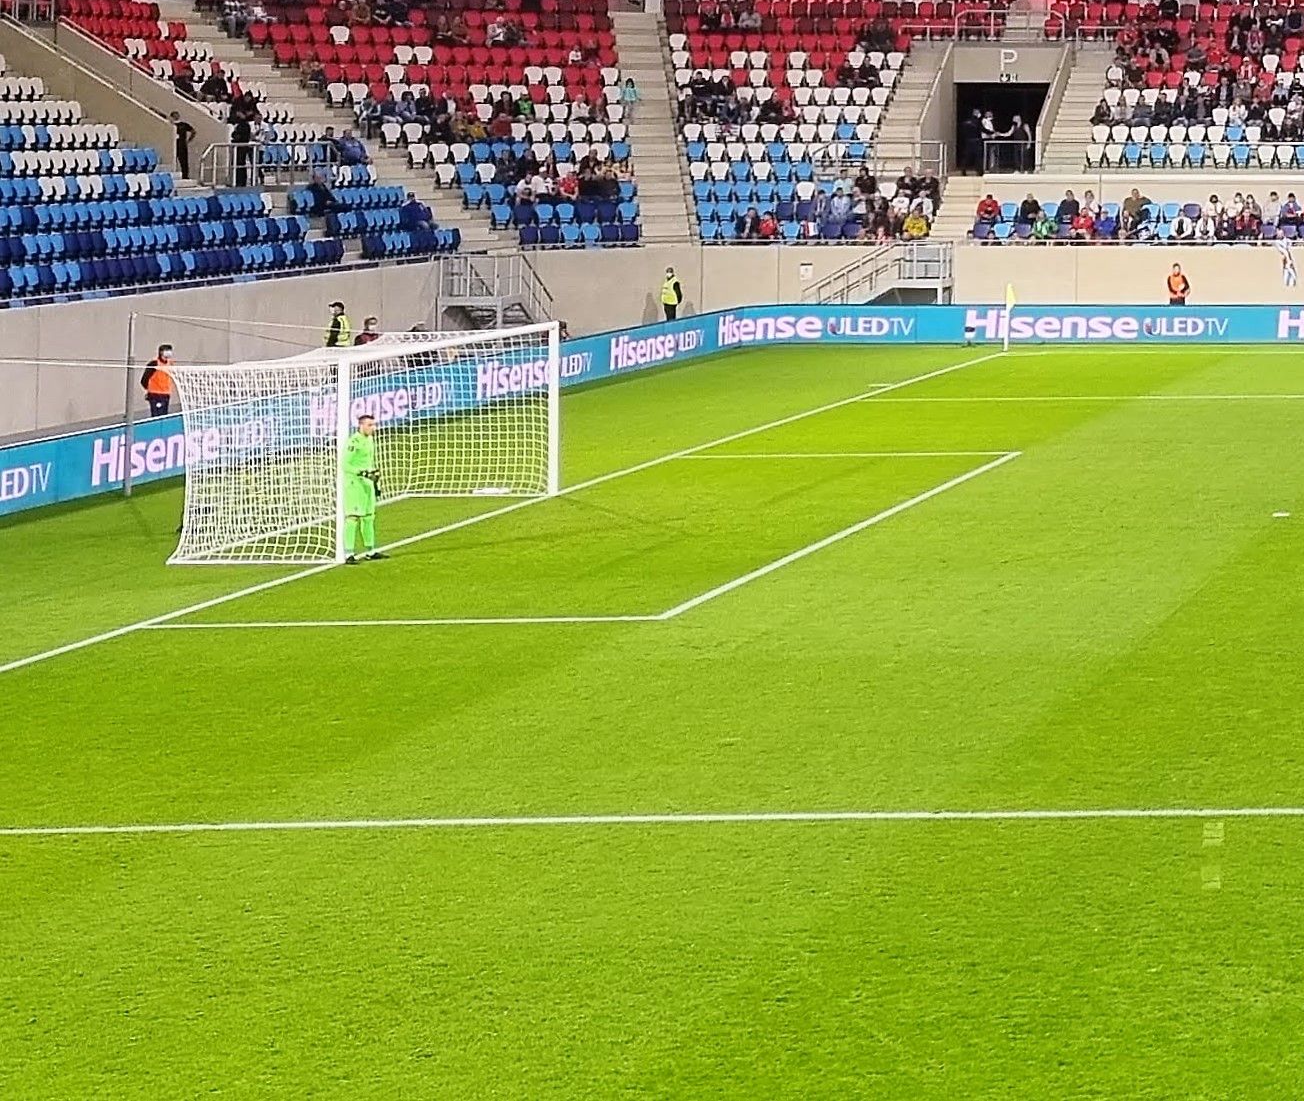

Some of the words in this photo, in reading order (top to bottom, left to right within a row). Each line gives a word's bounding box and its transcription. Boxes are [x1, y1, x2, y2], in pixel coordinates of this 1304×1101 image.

[1000, 49, 1018, 71] P
[717, 314, 822, 346] Hisense
[964, 309, 1139, 339] Hisense
[609, 333, 675, 371] Hisense
[311, 384, 409, 437] Hiense
